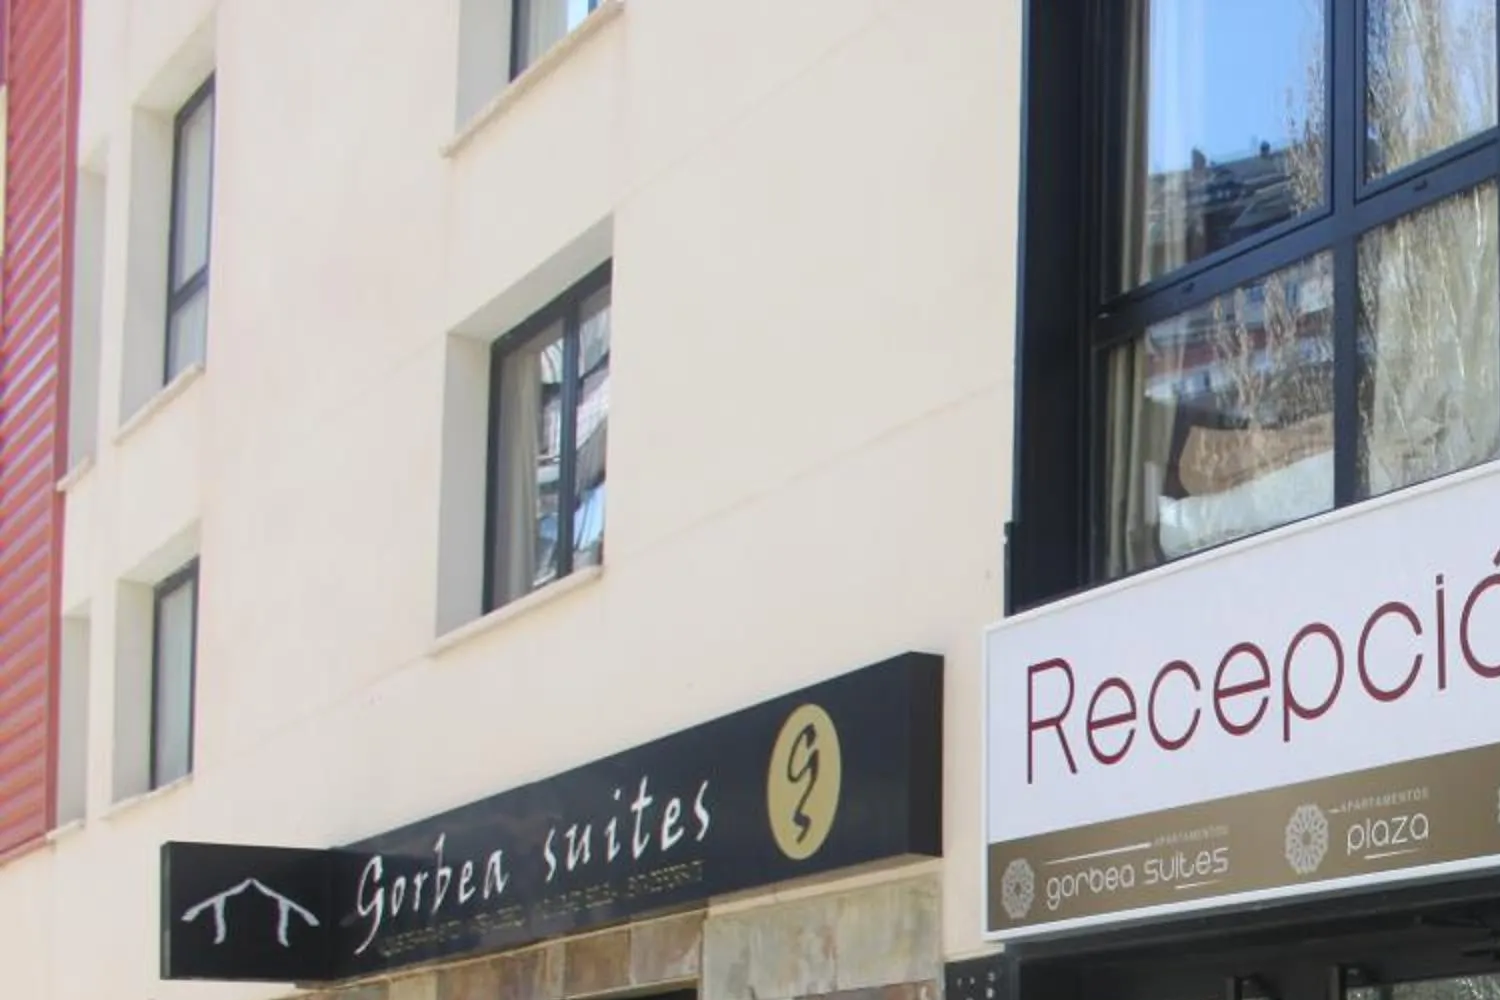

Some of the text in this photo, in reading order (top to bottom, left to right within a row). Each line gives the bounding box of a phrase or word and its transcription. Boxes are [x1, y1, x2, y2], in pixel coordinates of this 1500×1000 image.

[1340, 786, 1430, 813] APARTAMENTOS
[1347, 812, 1430, 856] plaza
[354, 776, 713, 956] Gorbea suites
[1046, 846, 1230, 911] gorbea suites
